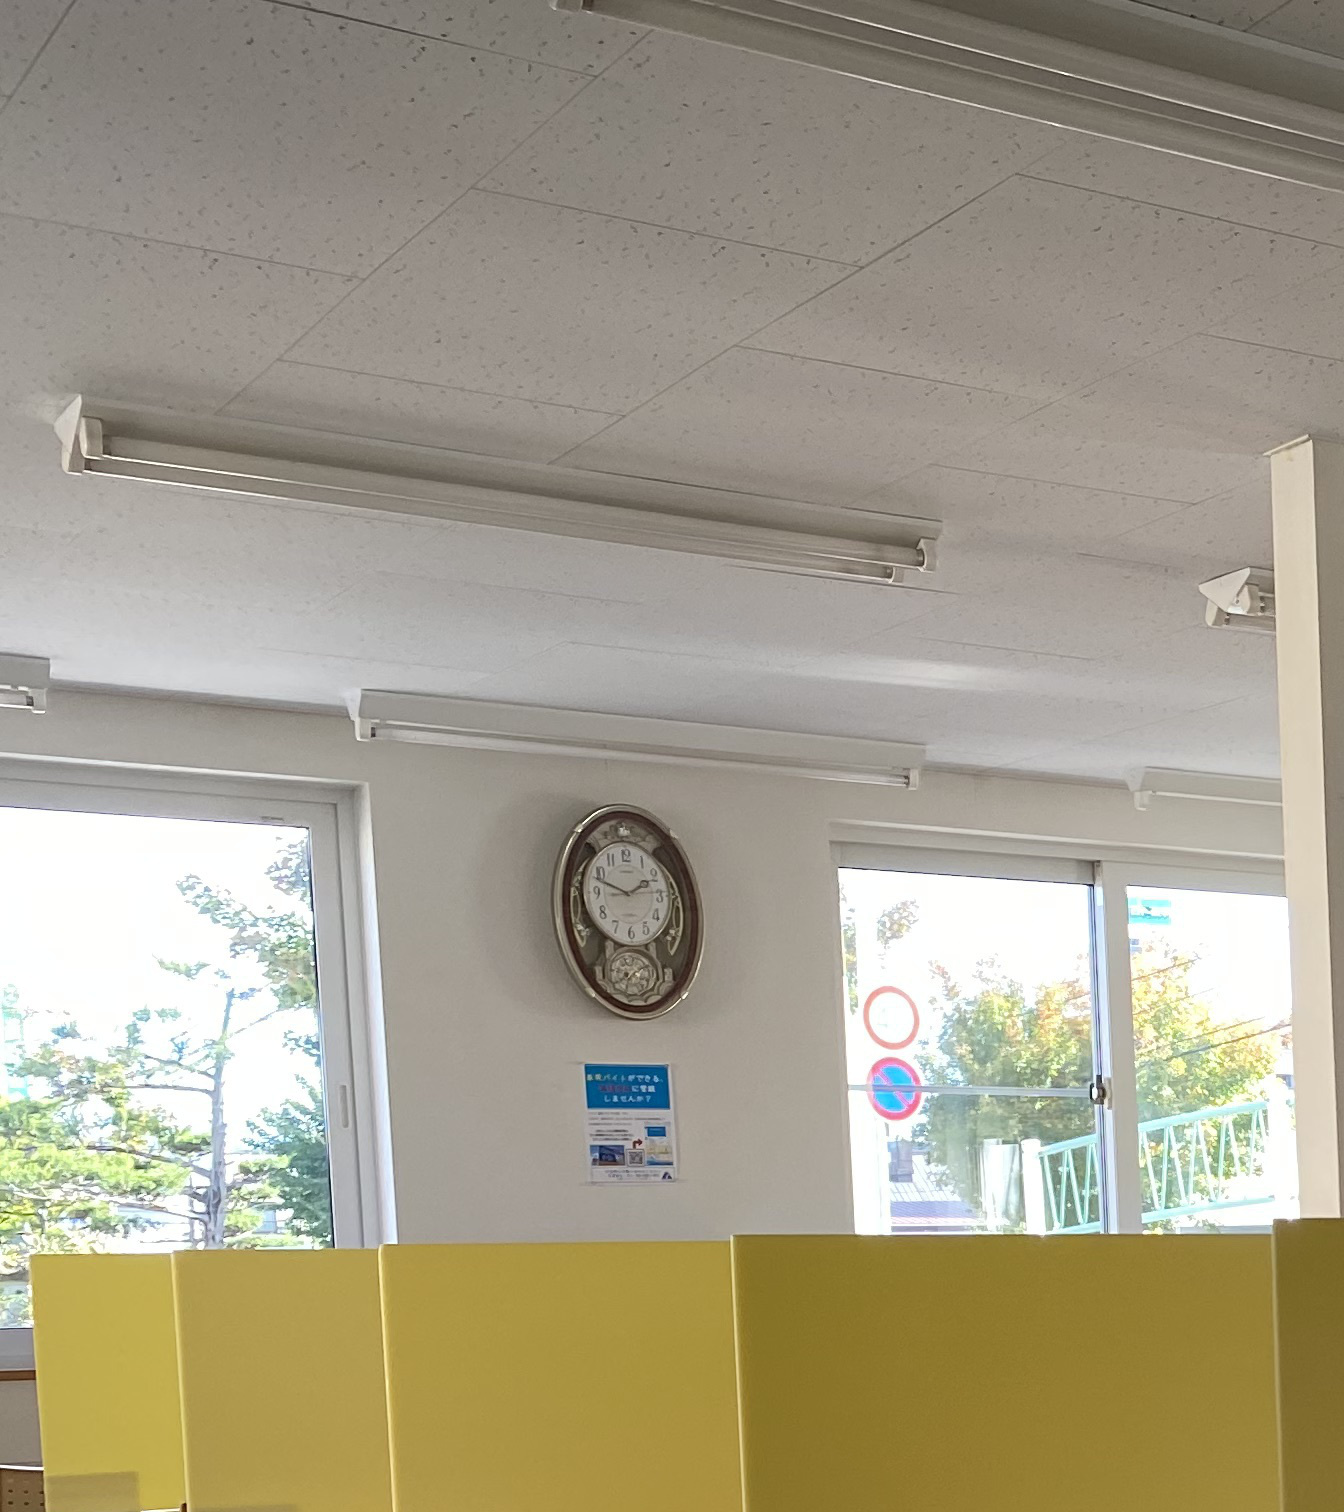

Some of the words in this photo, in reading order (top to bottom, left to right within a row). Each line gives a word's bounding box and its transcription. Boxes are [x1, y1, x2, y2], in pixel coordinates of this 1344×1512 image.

[607, 853, 615, 867] 11
[621, 849, 631, 862] 12
[639, 855, 645, 869] 1
[596, 866, 606, 881] 10
[593, 885, 601, 899] 9
[656, 889, 664, 903] 3
[599, 905, 607, 919] 8
[652, 908, 660, 921] 4
[612, 920, 620, 934] 7
[628, 926, 636, 940] 6
[642, 922, 650, 936] 5
